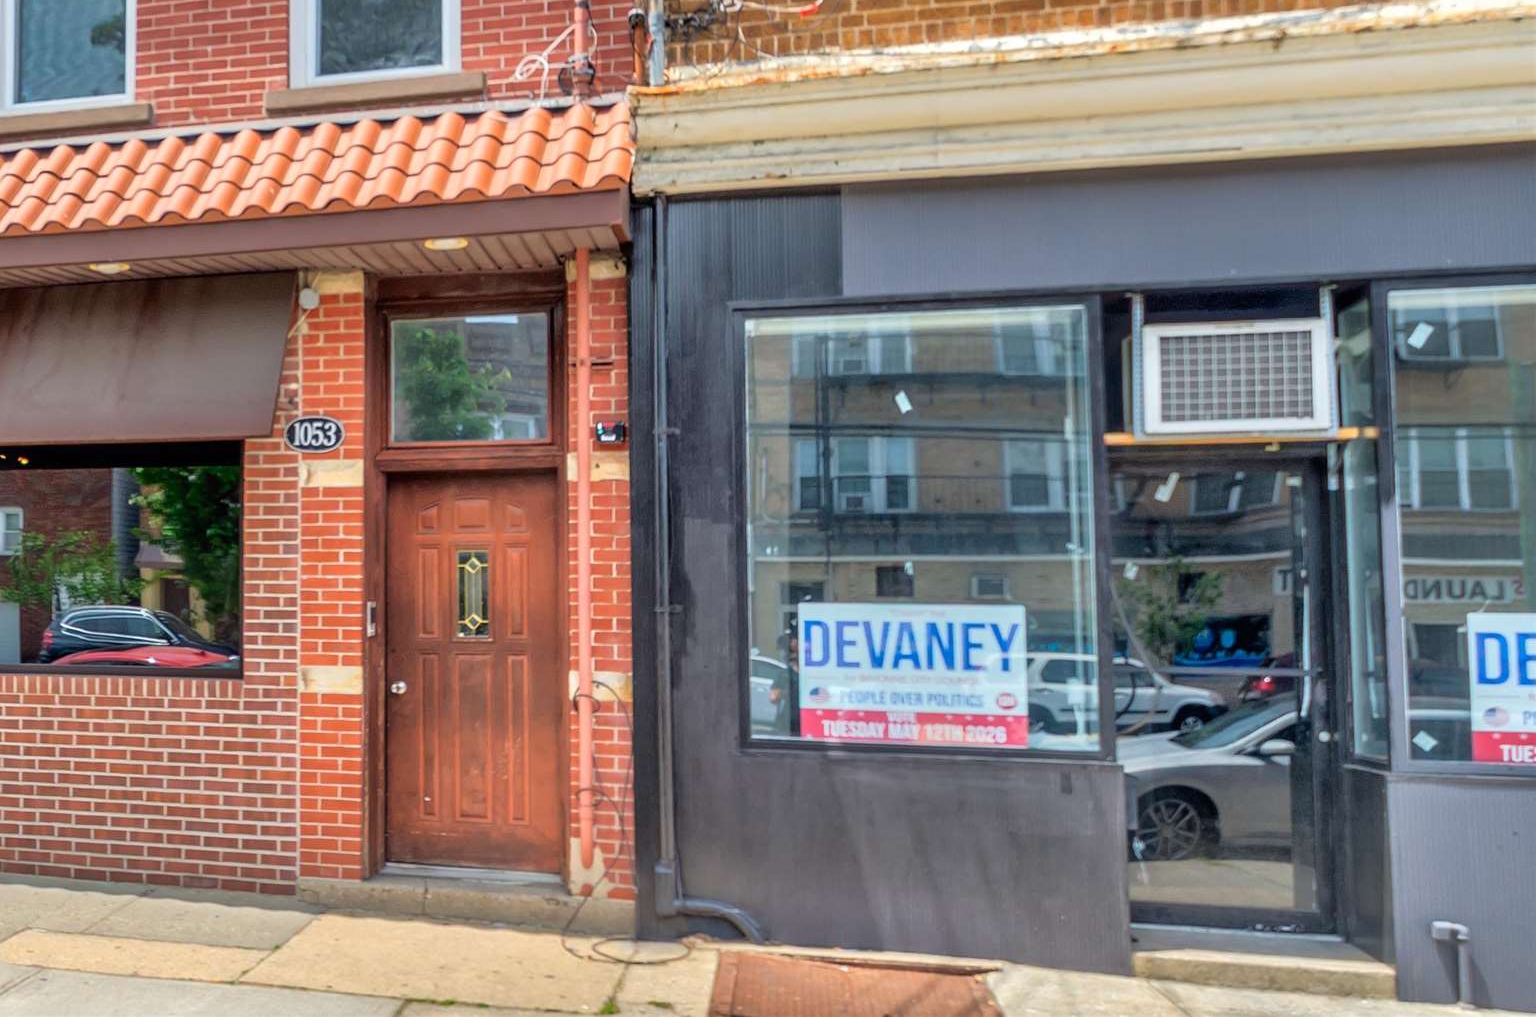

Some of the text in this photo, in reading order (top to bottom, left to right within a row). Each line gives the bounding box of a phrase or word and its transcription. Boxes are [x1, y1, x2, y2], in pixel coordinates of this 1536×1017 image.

[292, 421, 336, 446] 1053
[804, 619, 1020, 672] DEVANEY
[839, 689, 886, 706] PEOPLE
[889, 691, 925, 706] OVER
[926, 692, 985, 709] POLITICS
[821, 719, 1008, 744] TUESDAY MAY 12TH 2026
[1499, 743, 1536, 763] TUE
